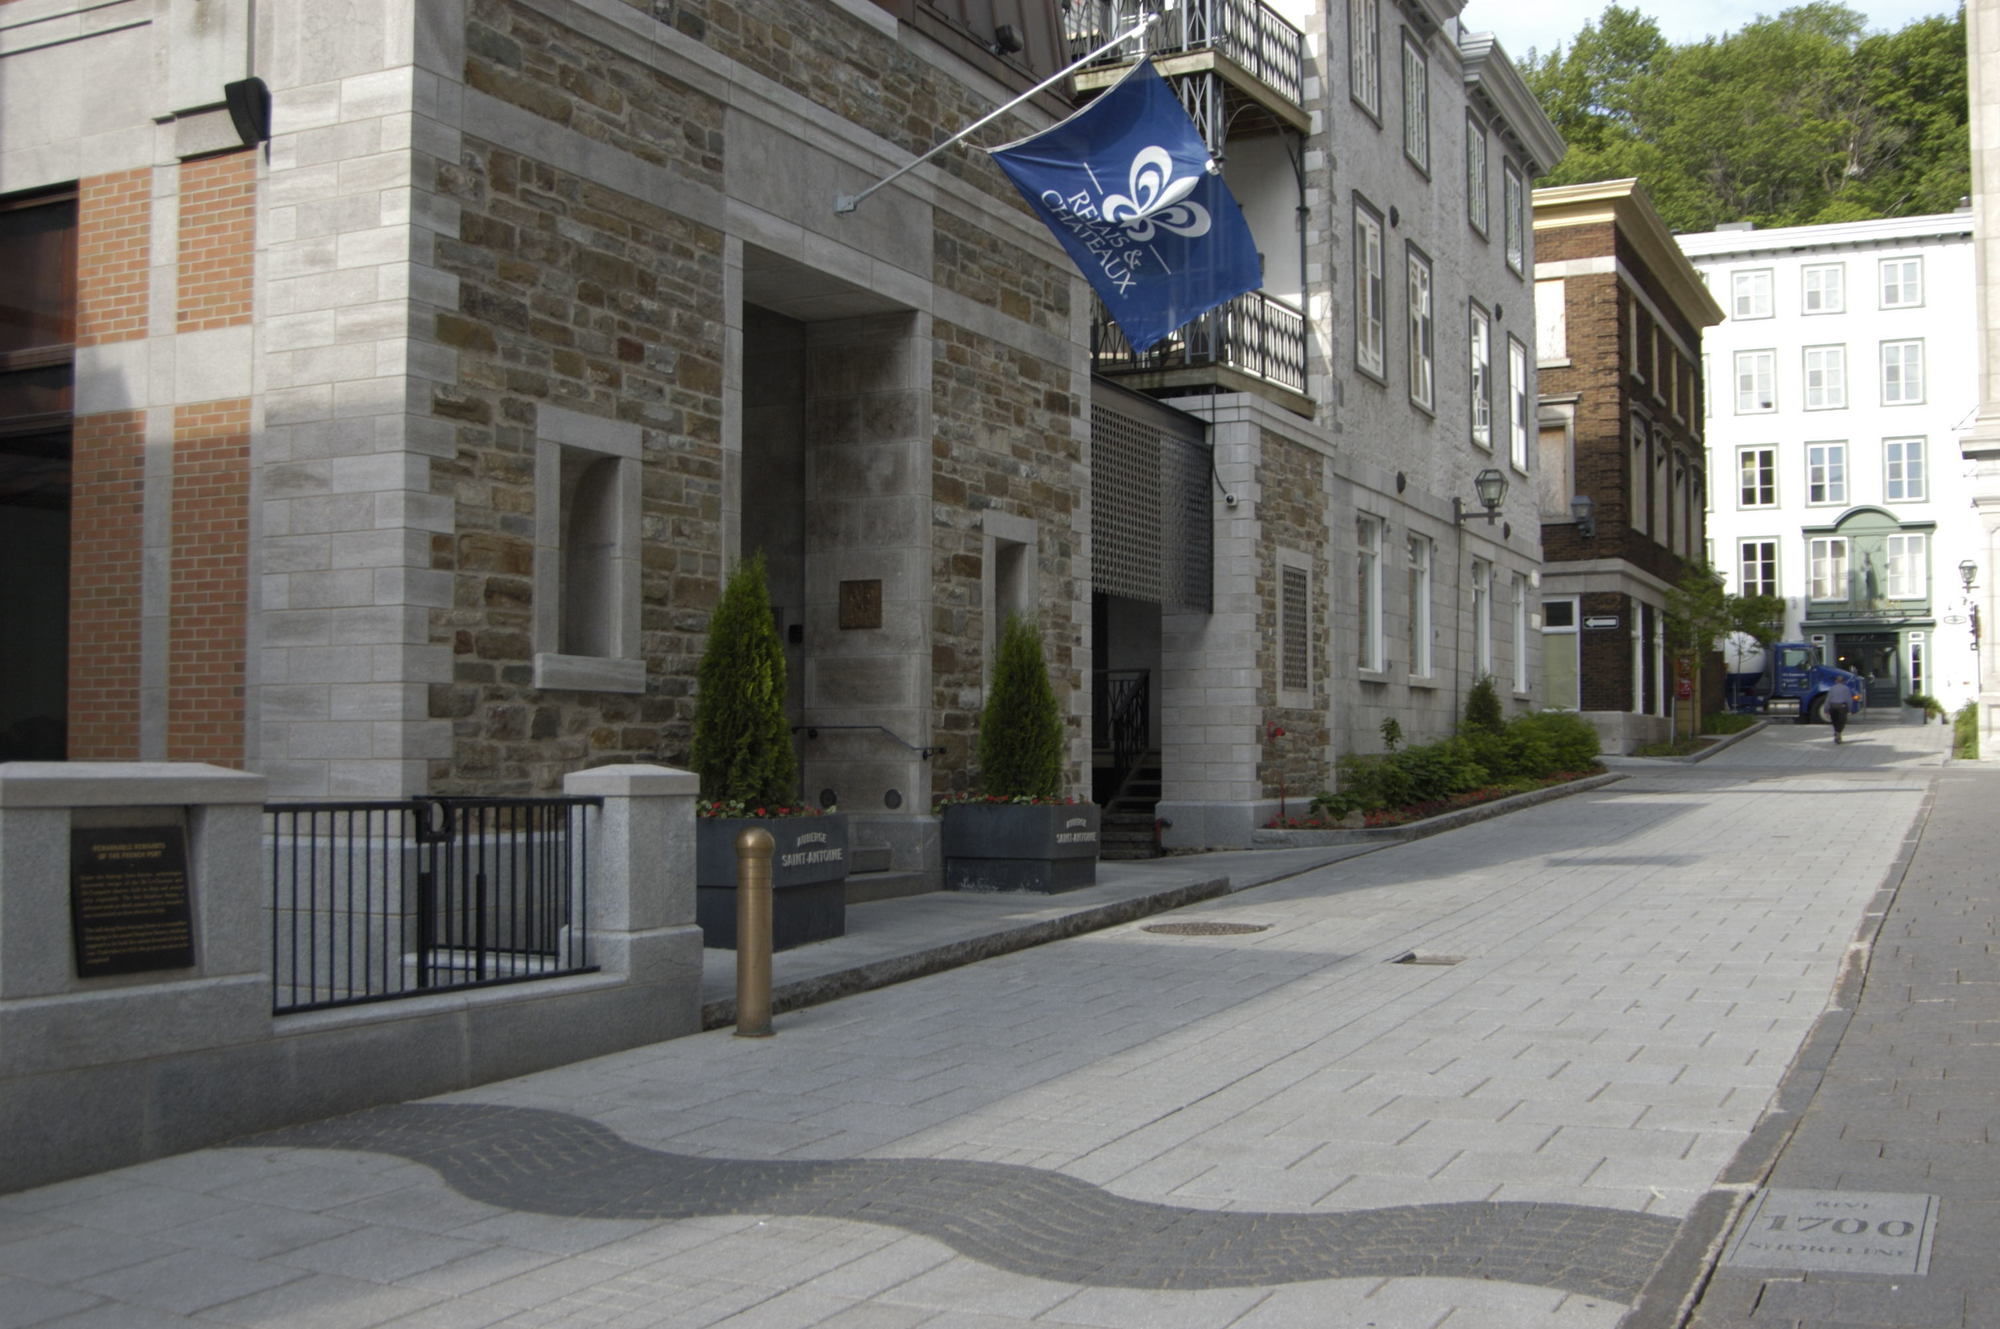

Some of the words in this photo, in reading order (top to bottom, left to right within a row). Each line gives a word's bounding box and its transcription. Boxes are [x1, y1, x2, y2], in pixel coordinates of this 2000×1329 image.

[1041, 190, 1136, 294] CHATEAUX
[1067, 189, 1130, 248] RELAIS
[1124, 249, 1143, 270] &
[1762, 1215, 1915, 1237] 1700
